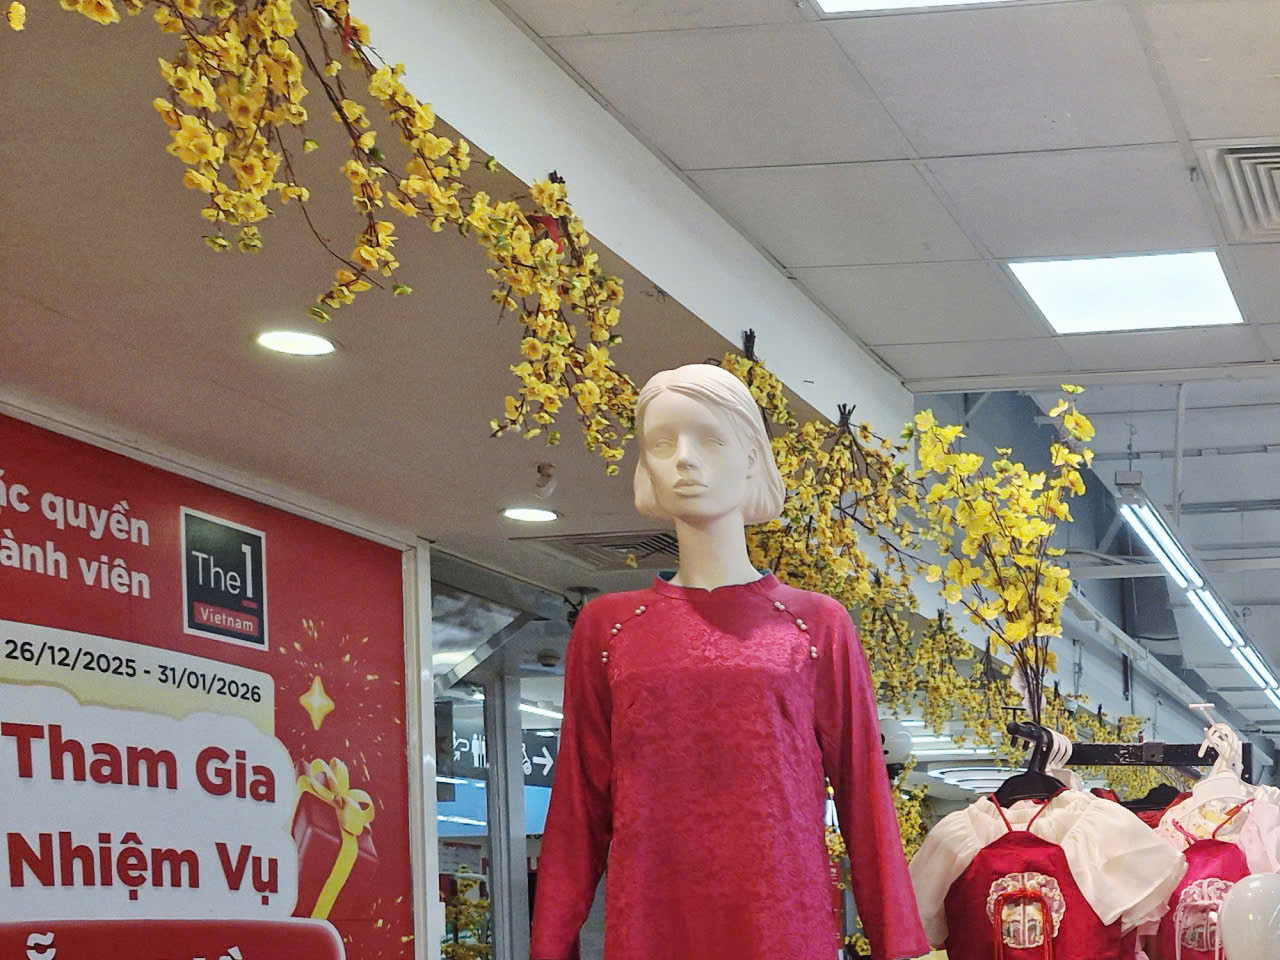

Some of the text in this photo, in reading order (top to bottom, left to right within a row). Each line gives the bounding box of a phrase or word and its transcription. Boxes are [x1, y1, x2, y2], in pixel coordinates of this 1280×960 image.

[41, 491, 150, 547] quyền
[78, 554, 151, 599] viên
[200, 607, 254, 632] Vietnam
[5, 639, 137, 678] 26/12/2025
[158, 664, 262, 703] 31/01/2026
[1, 722, 276, 803] Tham Gia
[7, 831, 279, 906] Nhiệm Vụ
